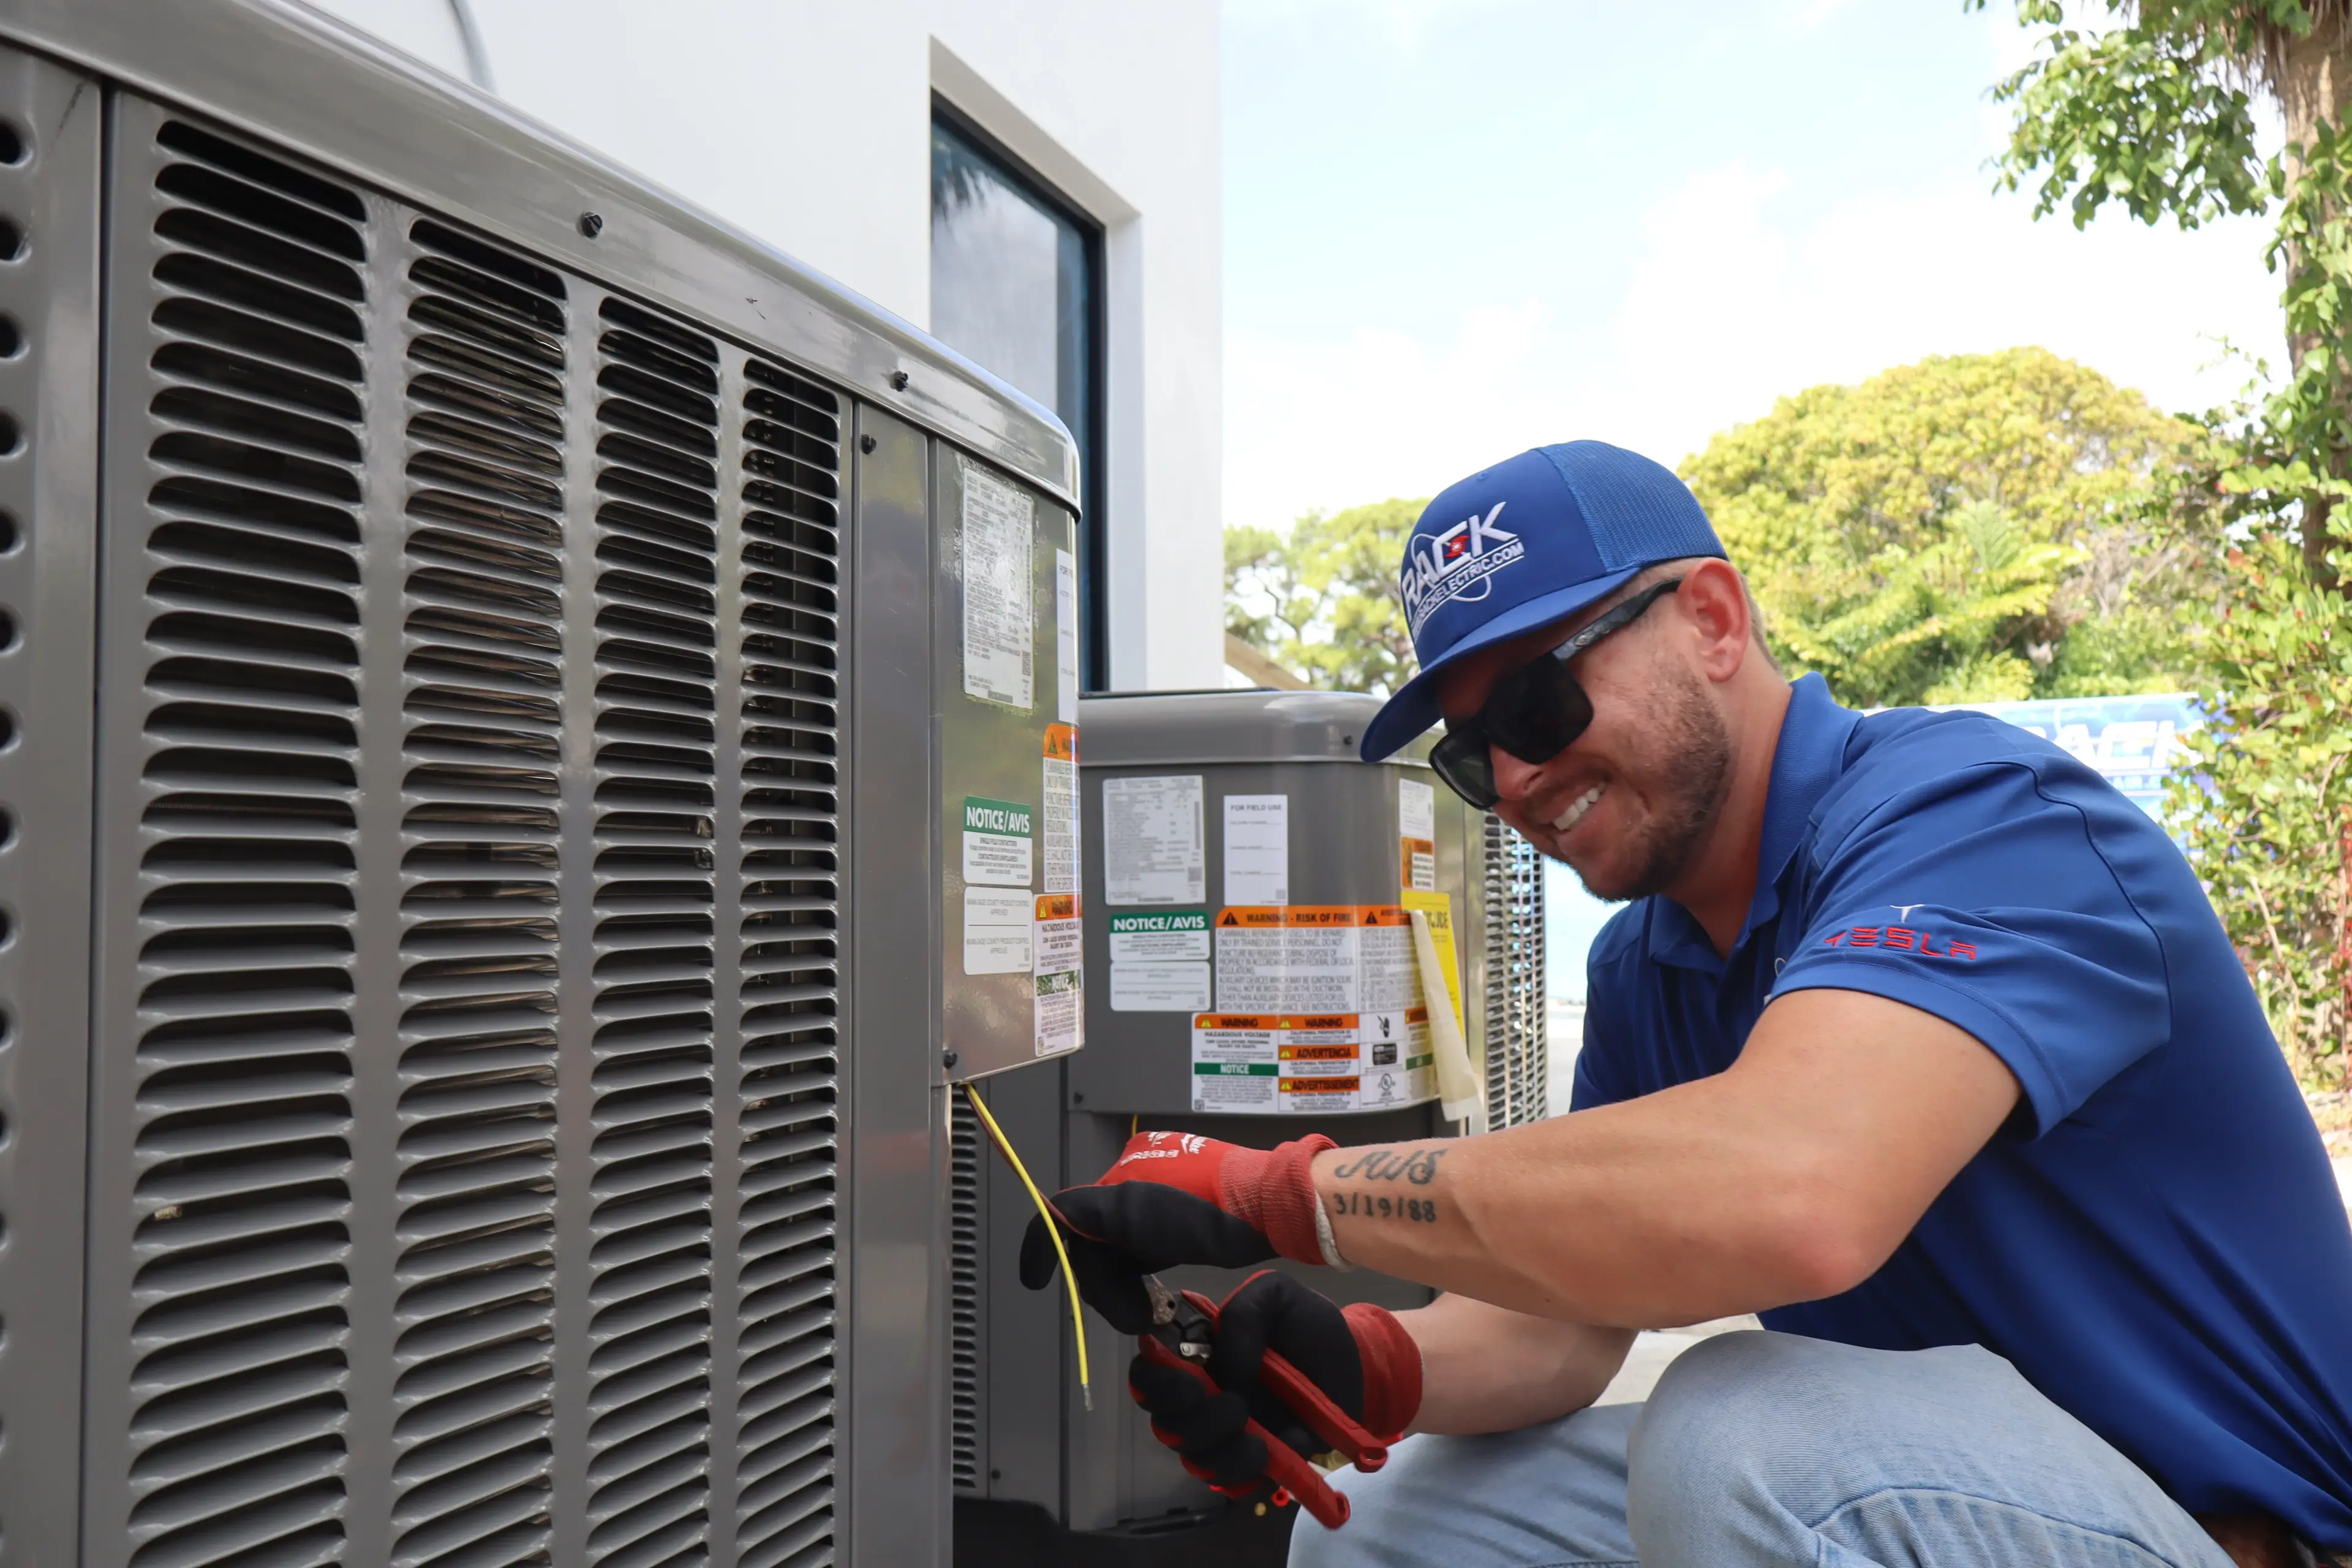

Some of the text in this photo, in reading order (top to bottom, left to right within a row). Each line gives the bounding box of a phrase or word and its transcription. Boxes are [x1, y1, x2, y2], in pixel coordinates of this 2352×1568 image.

[1402, 502, 1518, 620] RACK
[967, 806, 1030, 833] NOTICE/AVIS
[1114, 916, 1205, 931] NOTICE/AVIS
[1247, 914, 1287, 922] WARNING
[1296, 914, 1317, 922] RISK
[1319, 914, 1330, 922] OF
[1333, 914, 1351, 922] FIRE
[1824, 926, 1978, 960] TESLA
[1221, 1018, 1259, 1027] WARNING
[1305, 1018, 1343, 1027] WARNING
[1297, 1048, 1351, 1058] ADVERTENCIA
[1220, 1064, 1250, 1074] NOTICE
[1293, 1079, 1359, 1090] ADVERTISSEMENT
[1333, 1192, 1436, 1223] 3/19/88
